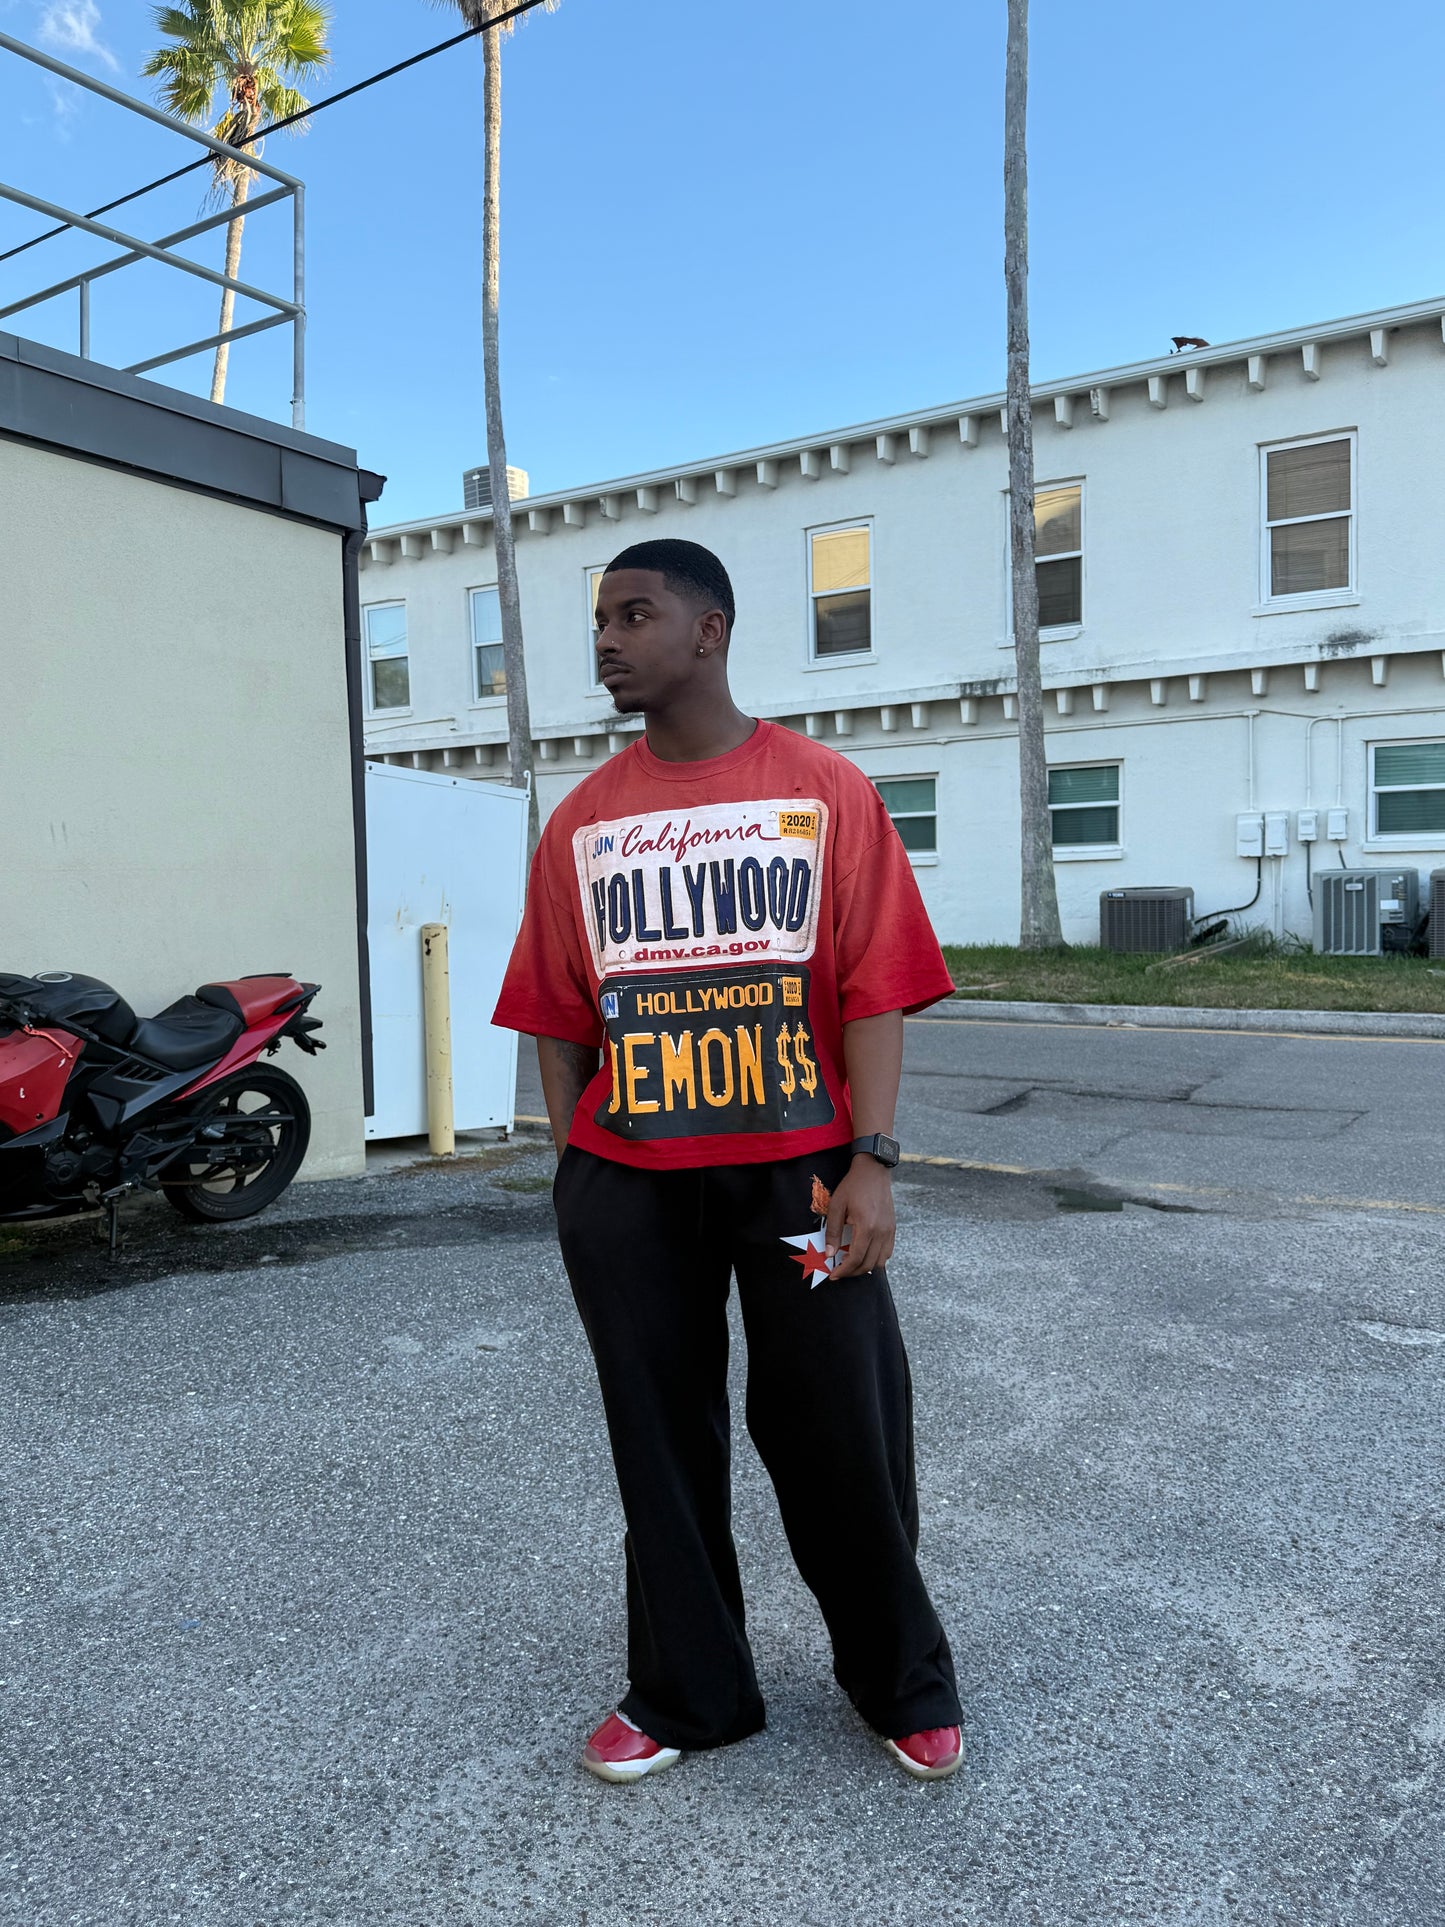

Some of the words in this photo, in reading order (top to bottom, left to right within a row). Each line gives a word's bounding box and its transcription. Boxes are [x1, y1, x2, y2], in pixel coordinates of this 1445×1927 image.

[786, 814, 811, 828] 2020
[592, 835, 615, 860] JUN
[621, 815, 782, 863] California
[591, 856, 812, 952] HOLLYWOOD
[633, 938, 771, 962] dmv.ca.gov
[636, 982, 773, 1016] HOLLYWOOD
[775, 1021, 818, 1102] $$
